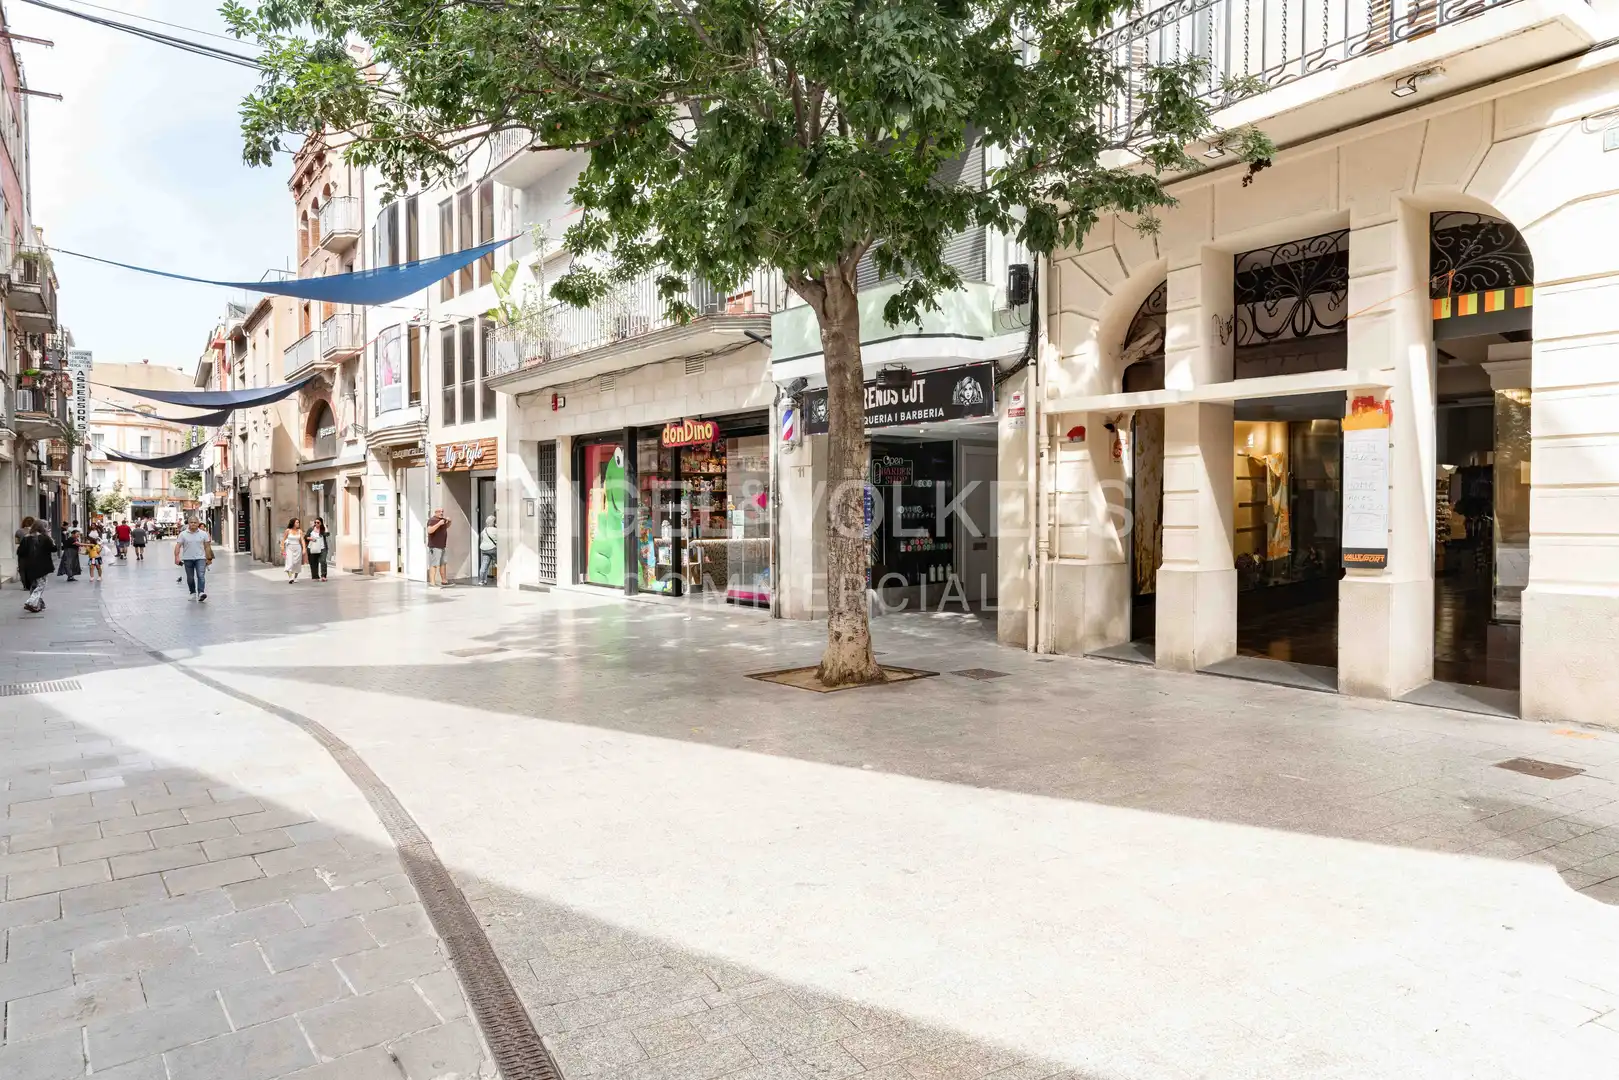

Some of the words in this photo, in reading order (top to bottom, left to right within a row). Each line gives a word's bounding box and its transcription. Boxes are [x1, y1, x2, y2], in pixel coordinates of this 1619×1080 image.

[76, 370, 86, 430] ASSESSORS
[900, 407, 945, 421] BARBERIA
[441, 445, 457, 469] My
[457, 441, 483, 467] Style
[882, 455, 904, 466] Open
